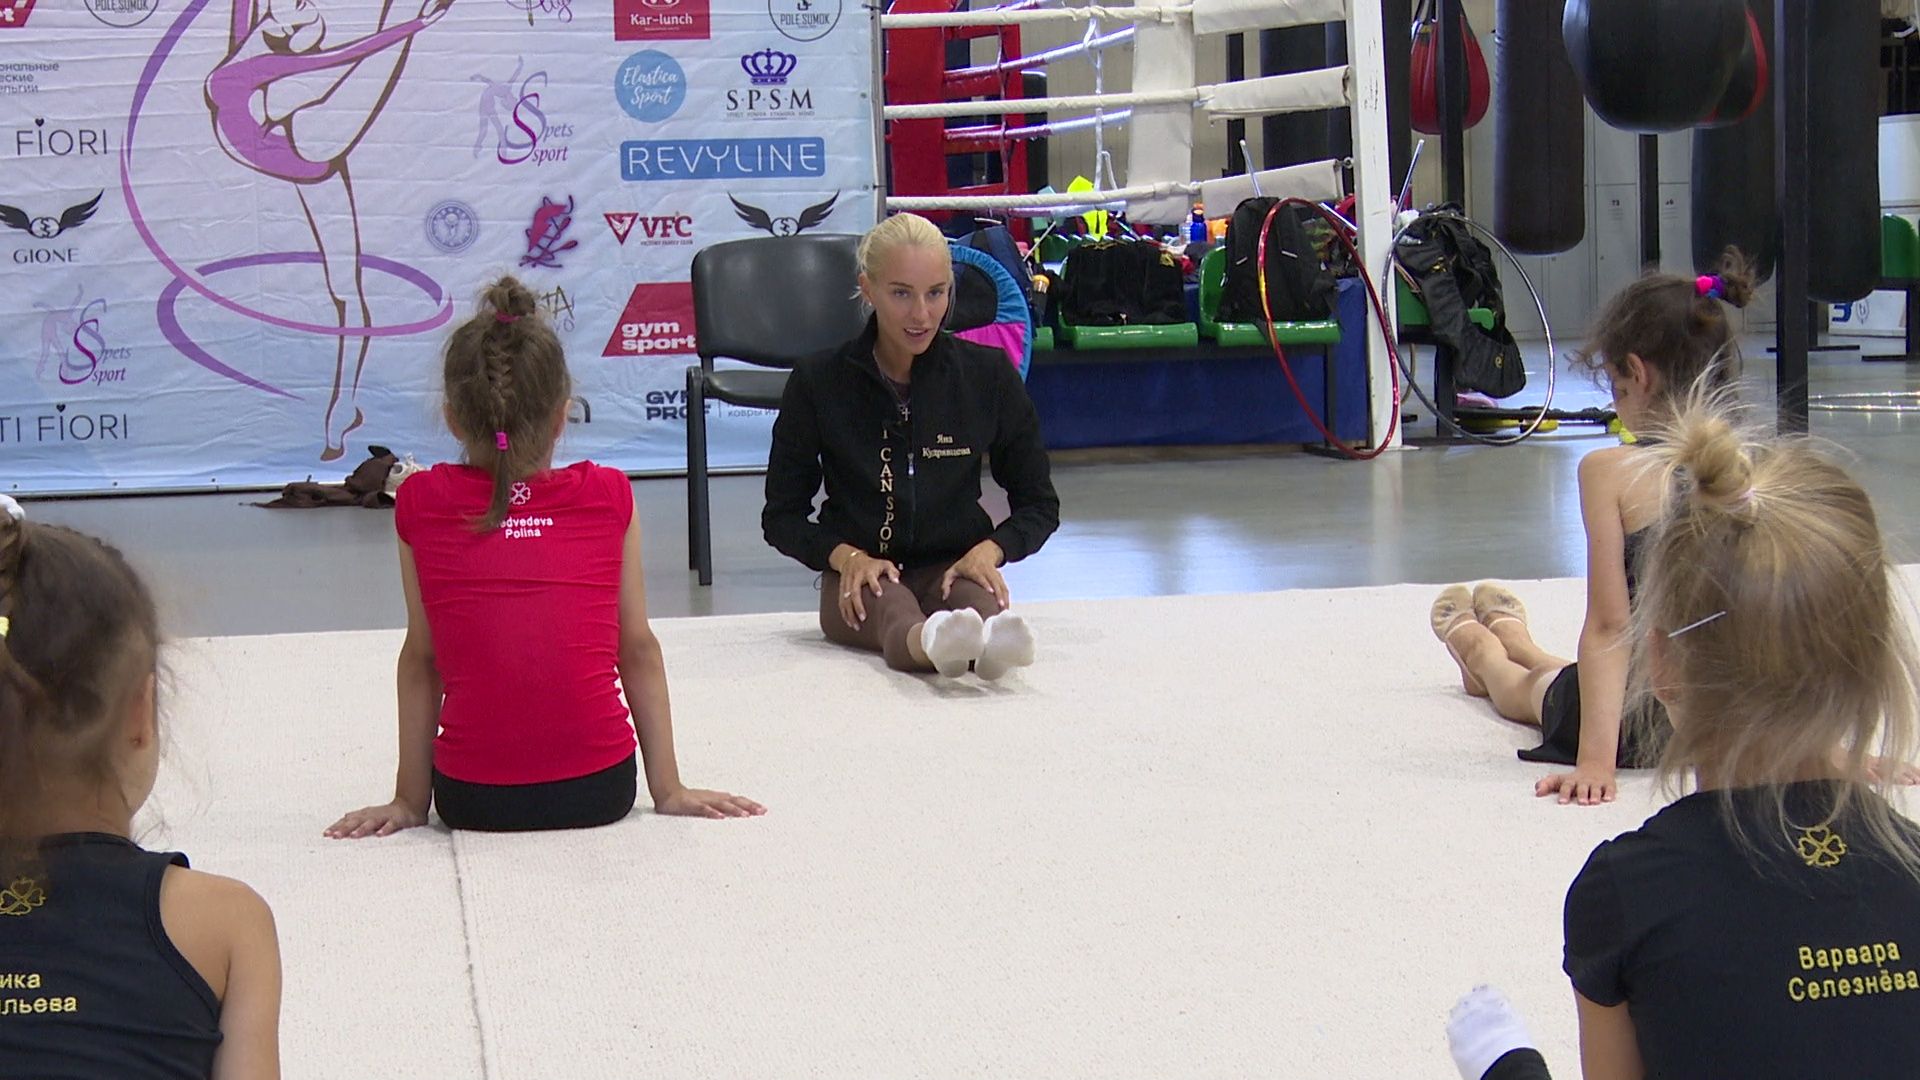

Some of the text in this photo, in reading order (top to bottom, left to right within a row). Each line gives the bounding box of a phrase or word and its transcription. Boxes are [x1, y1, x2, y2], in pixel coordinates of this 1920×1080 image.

[630, 13, 693, 26] Kar-lunch
[622, 66, 679, 87] Elastica
[630, 85, 672, 110] Sport
[628, 144, 819, 176] REVYLINE
[639, 215, 692, 238] VFC
[13, 248, 80, 264] GIONE
[621, 321, 680, 338] gym
[622, 334, 696, 353] sport
[936, 433, 954, 444] Яна
[496, 515, 554, 528] edvedeva
[505, 528, 542, 539] Polina
[1798, 942, 1900, 973] Варвара
[1788, 968, 1920, 1002] Селезнёва
[0, 996, 77, 1016] льева
